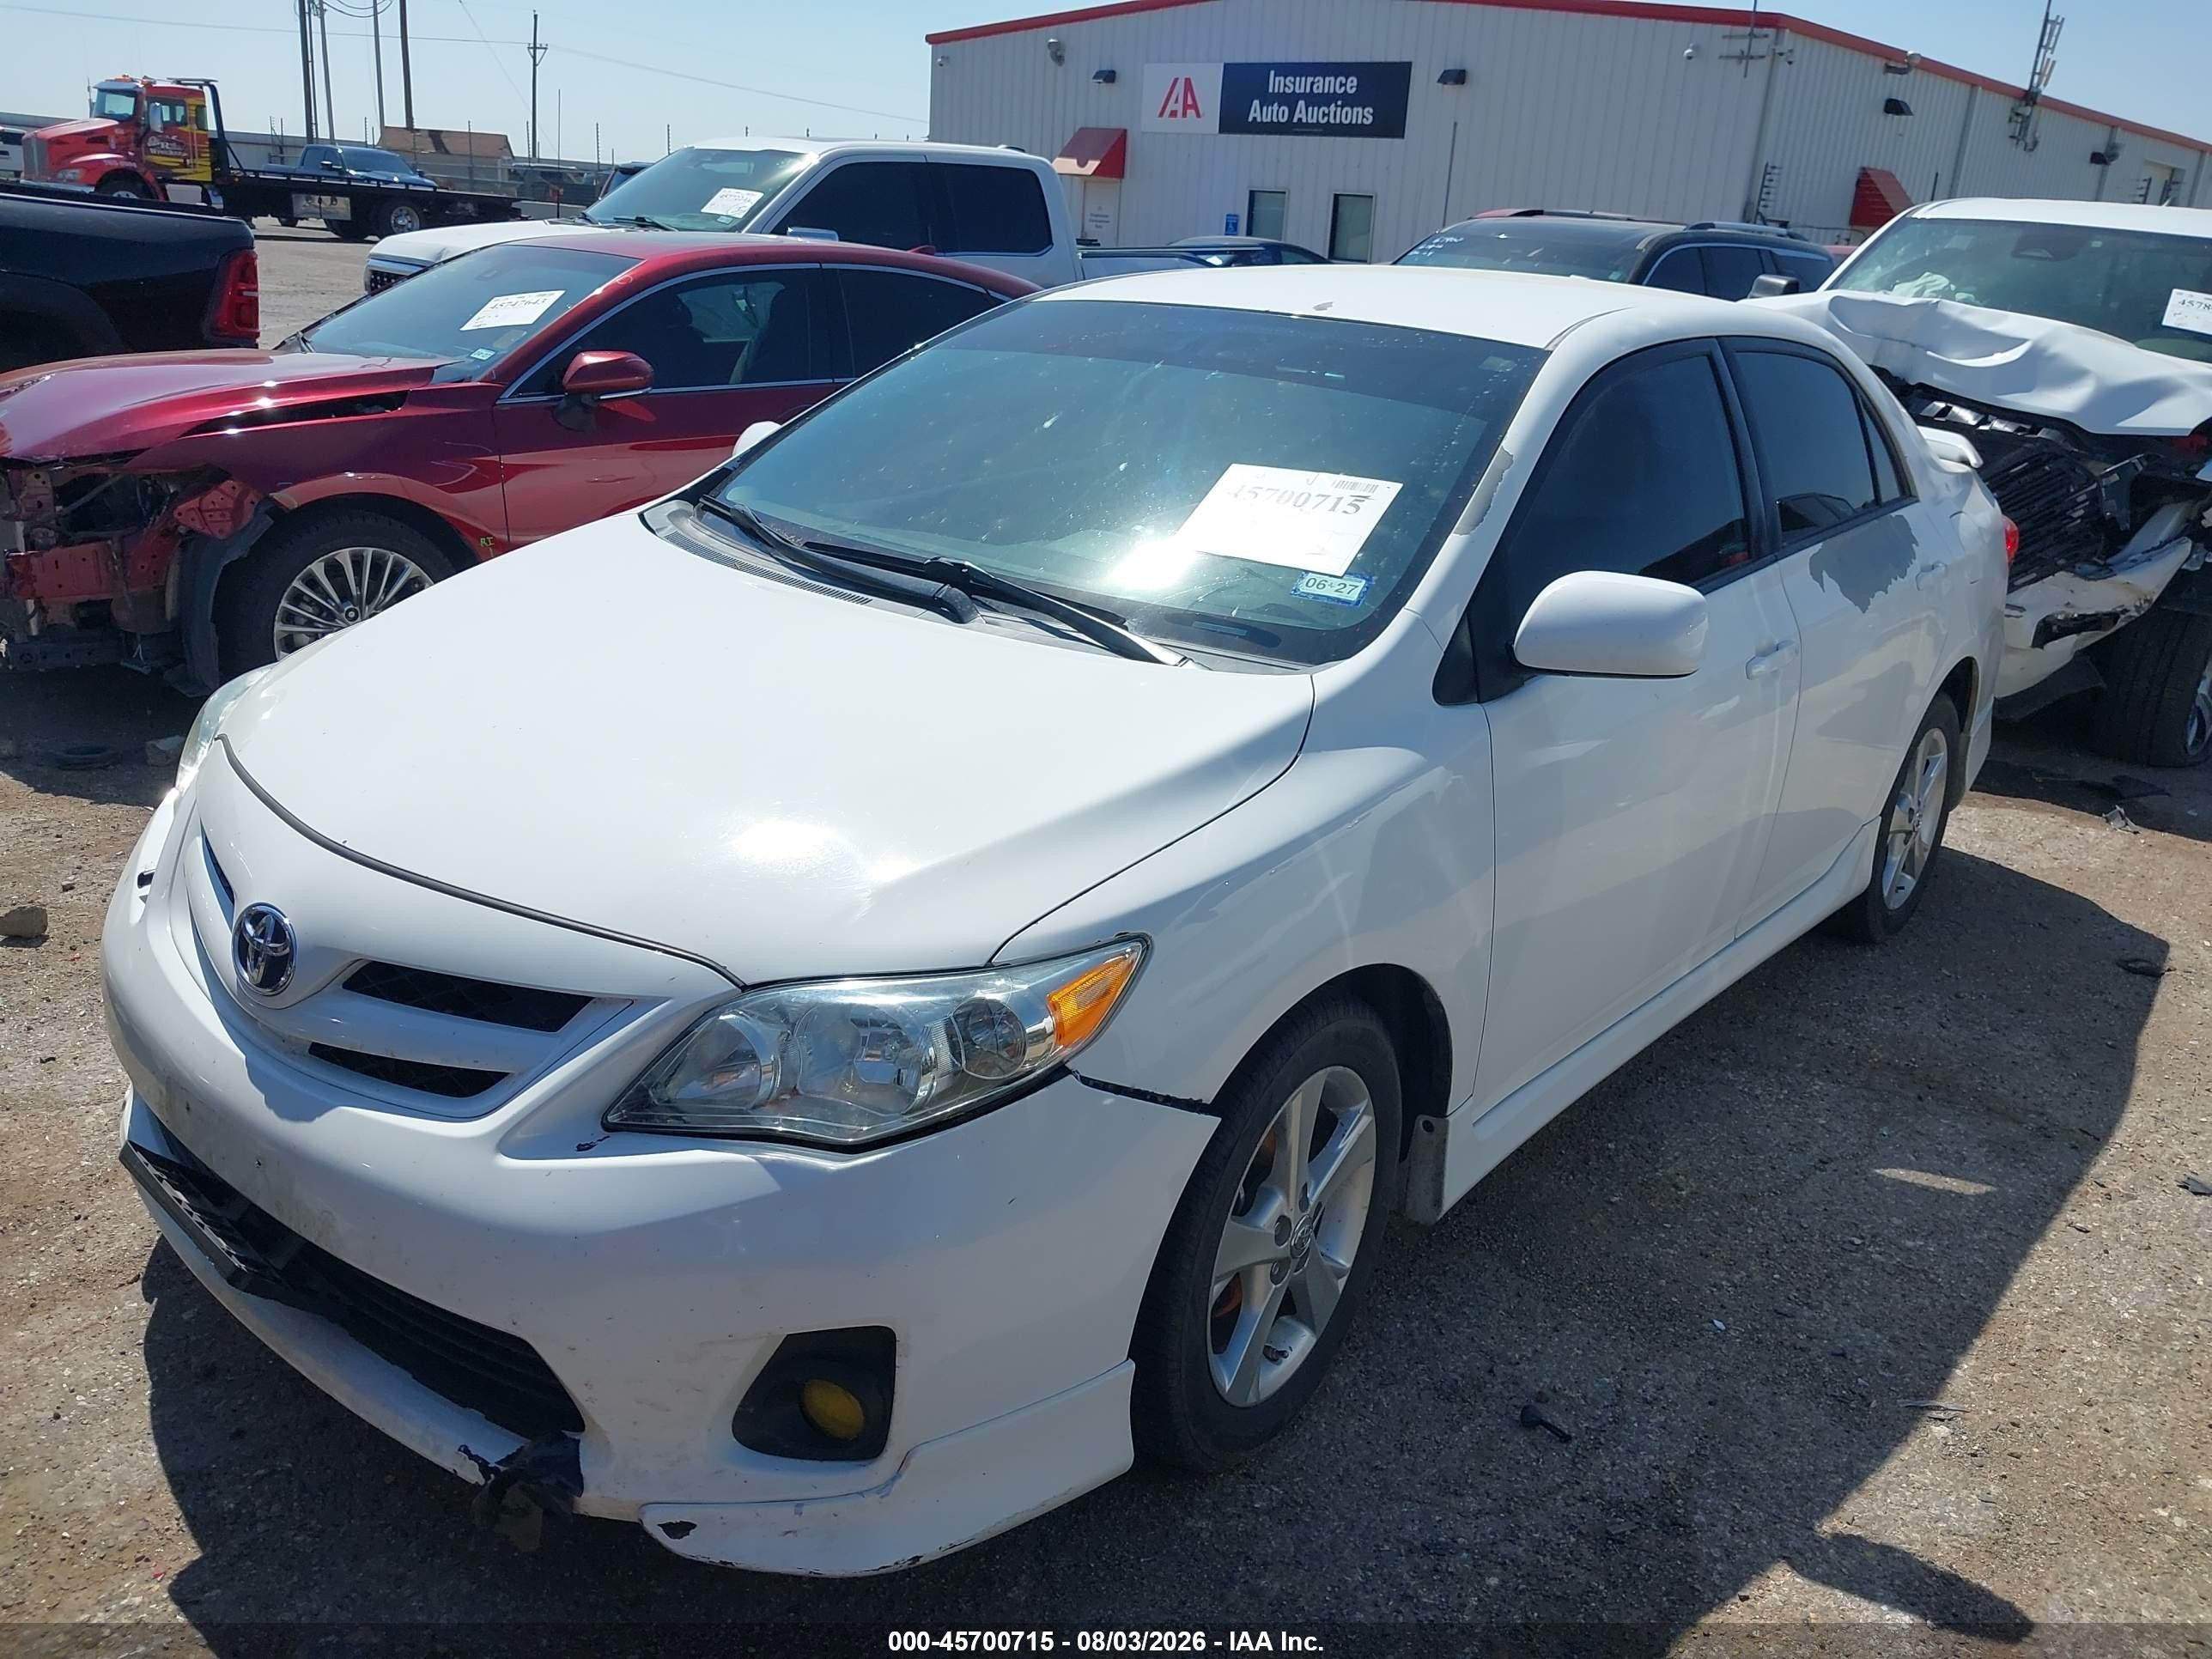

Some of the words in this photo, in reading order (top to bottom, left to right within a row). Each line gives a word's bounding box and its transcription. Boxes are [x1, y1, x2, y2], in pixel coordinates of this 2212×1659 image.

[1267, 70, 1358, 94] Insurance
[1247, 99, 1289, 123] Auto
[1291, 99, 1374, 125] Auctions
